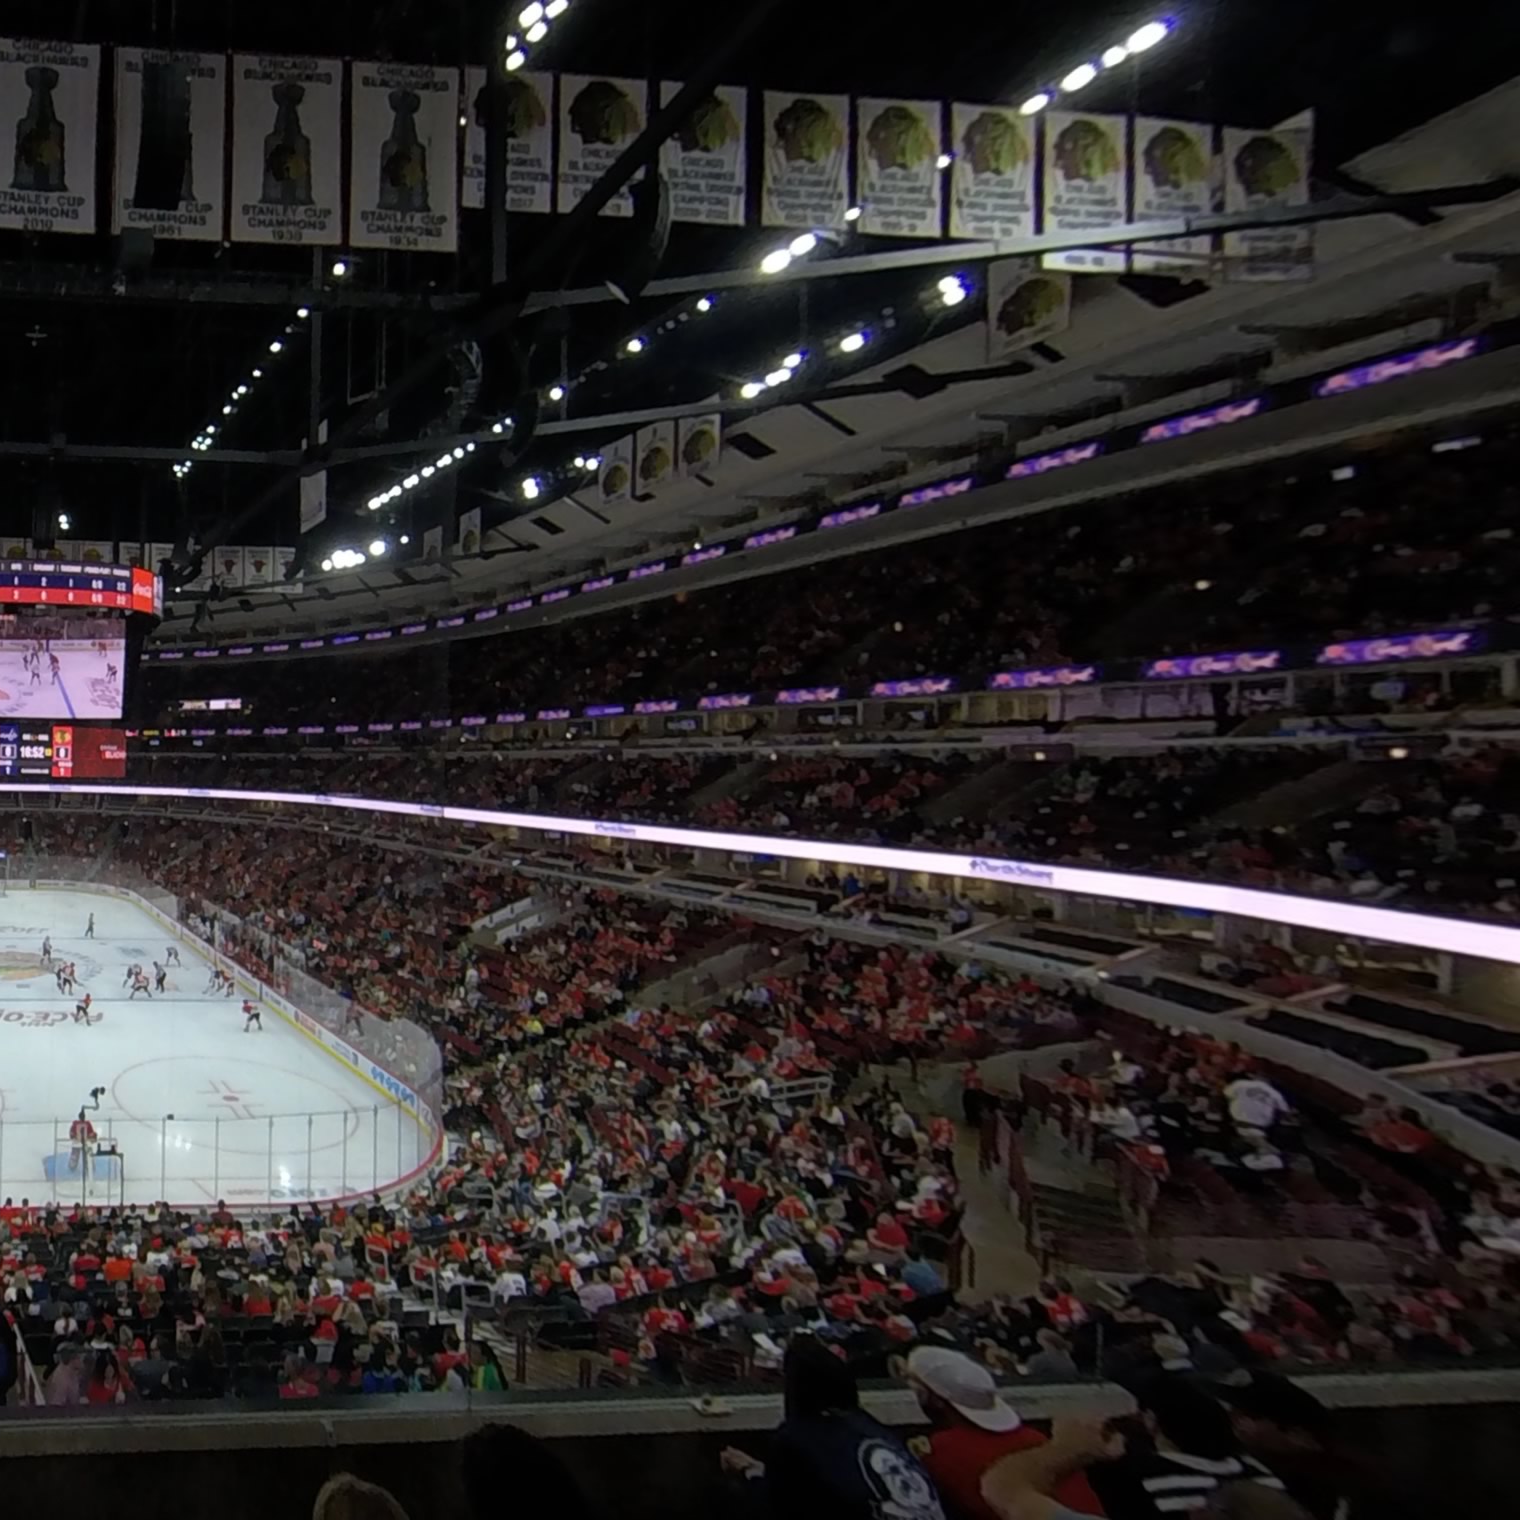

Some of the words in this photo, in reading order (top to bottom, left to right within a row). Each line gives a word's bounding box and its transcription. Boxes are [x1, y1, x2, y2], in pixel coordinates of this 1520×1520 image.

[12, 39, 74, 54] CHICAGO
[258, 56, 318, 71] CHICAGO
[377, 65, 435, 79] CHICAGO
[57, 195, 85, 207] CUP
[185, 202, 213, 213] CUP
[128, 211, 207, 226] CHAMPIONS
[242, 204, 298, 218] STANLEY
[304, 207, 332, 219] CUP
[360, 211, 415, 224] STANLEY
[421, 213, 448, 225] CUP
[23, 217, 54, 231] 2010
[248, 217, 327, 231] CHAMPIONS
[367, 223, 443, 237] CHAMPIONS
